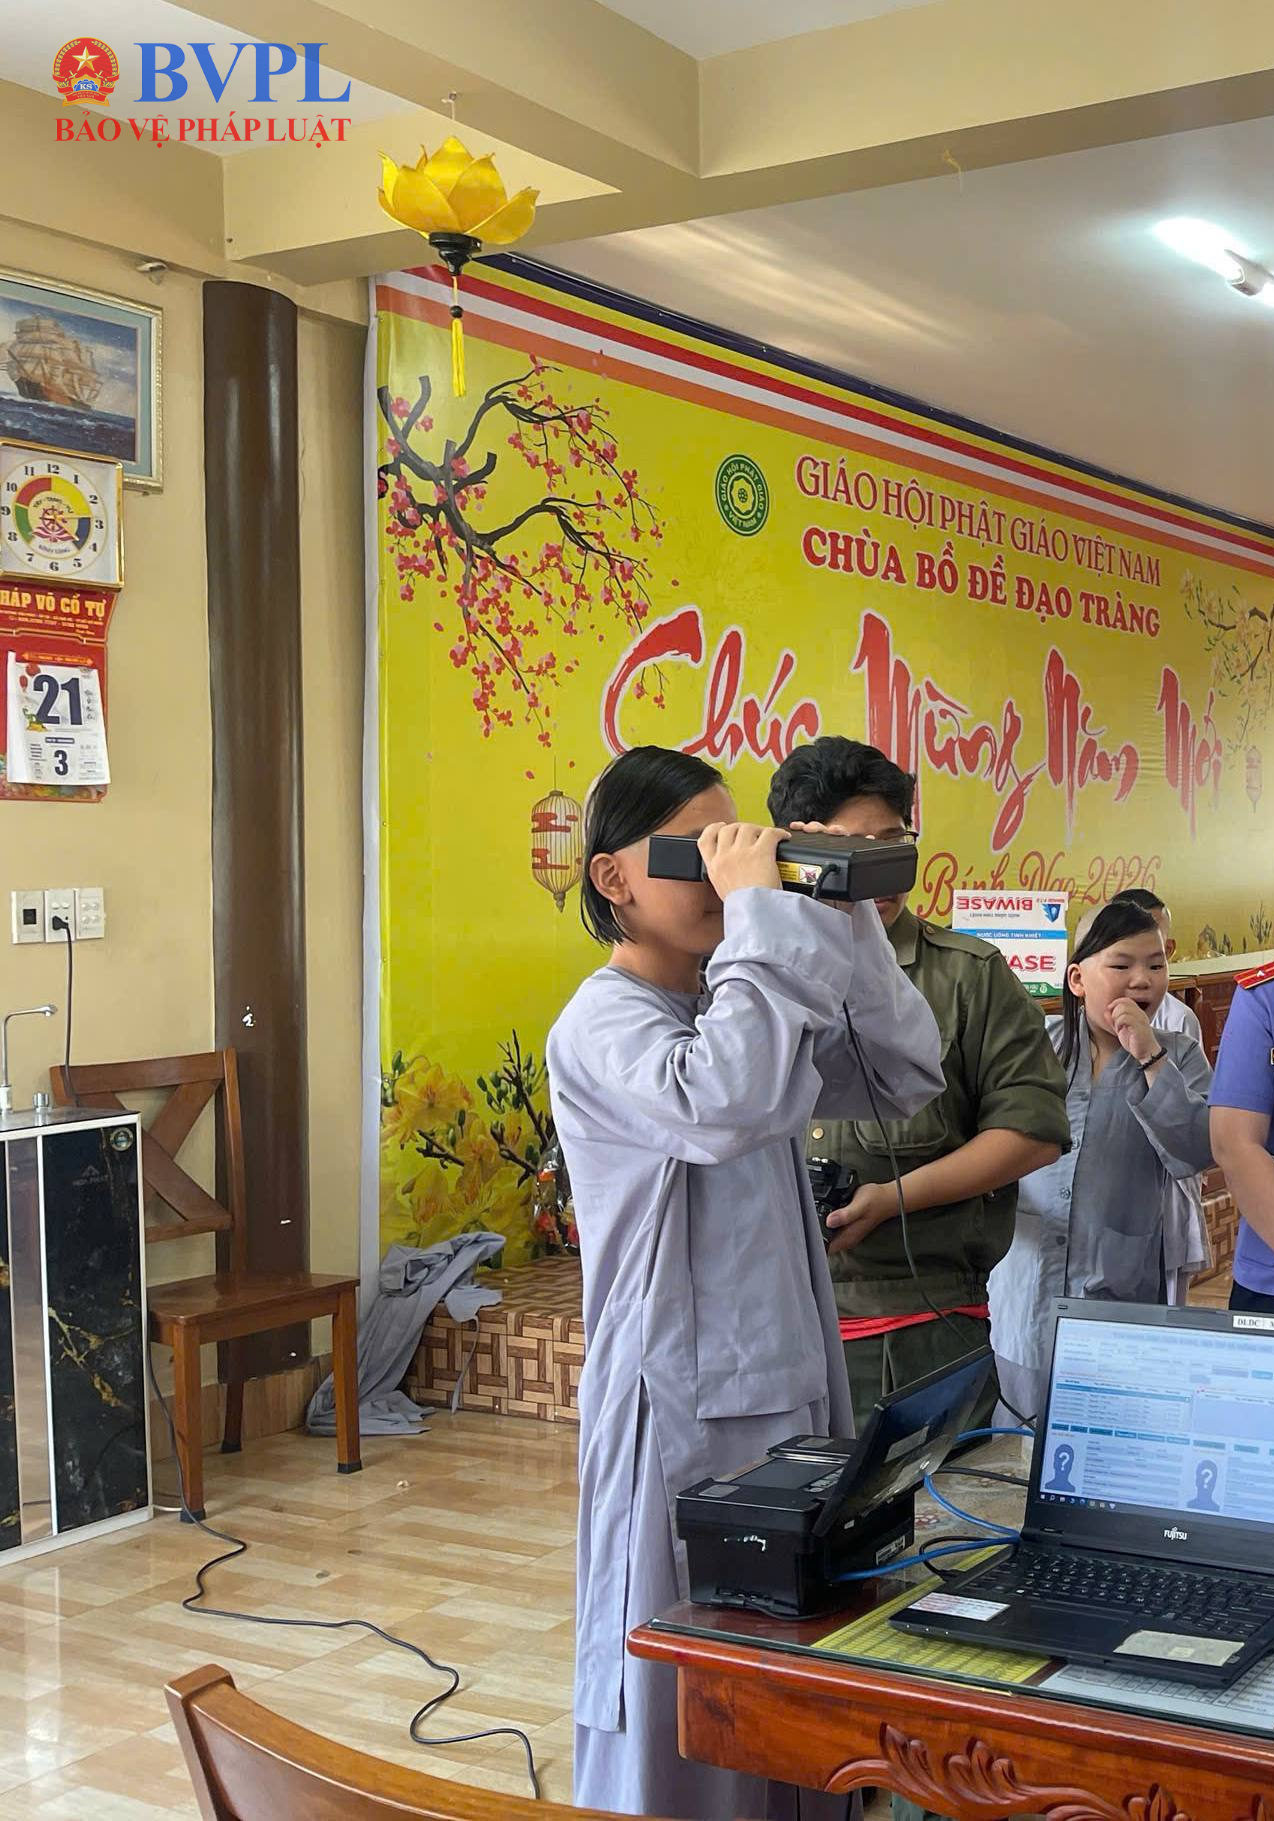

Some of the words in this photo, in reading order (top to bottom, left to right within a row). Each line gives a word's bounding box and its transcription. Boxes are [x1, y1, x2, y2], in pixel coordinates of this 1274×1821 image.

[24, 465, 35, 476] 11
[47, 464, 60, 474] 12
[73, 474, 79, 484] 1
[6, 482, 18, 492] 10
[89, 495, 98, 504] 2
[0, 506, 11, 516] 9
[95, 520, 104, 529] 3
[796, 456, 878, 511] GIÁO
[882, 478, 934, 530] HỘI
[939, 495, 1007, 548] PHẬT
[1010, 517, 1068, 561] GIÁO
[1072, 535, 1115, 577] VIỆT
[1119, 548, 1160, 586] NAM
[8, 532, 18, 541] 8
[89, 543, 97, 552] 4
[26, 553, 34, 562] 7
[73, 558, 82, 567] 5
[49, 562, 59, 571] 6
[803, 527, 906, 584] CHÙA
[916, 541, 958, 594] BỒ
[968, 554, 1007, 605] ĐỀ
[1015, 576, 1072, 623] ĐẠO
[1079, 591, 1160, 637] TRÀNG
[36, 592, 56, 611] VÔ
[60, 593, 80, 614] CỐ
[33, 674, 83, 725] 21
[604, 610, 819, 765] Chúc
[853, 613, 1046, 850] Mừng
[1045, 648, 1139, 826] Năm
[54, 749, 69, 776] 3
[1086, 855, 1162, 905] 2026
[957, 896, 1033, 911] BIWASE
[1006, 955, 1056, 972] ASE
[1164, 1527, 1187, 1540] FUJITSU
